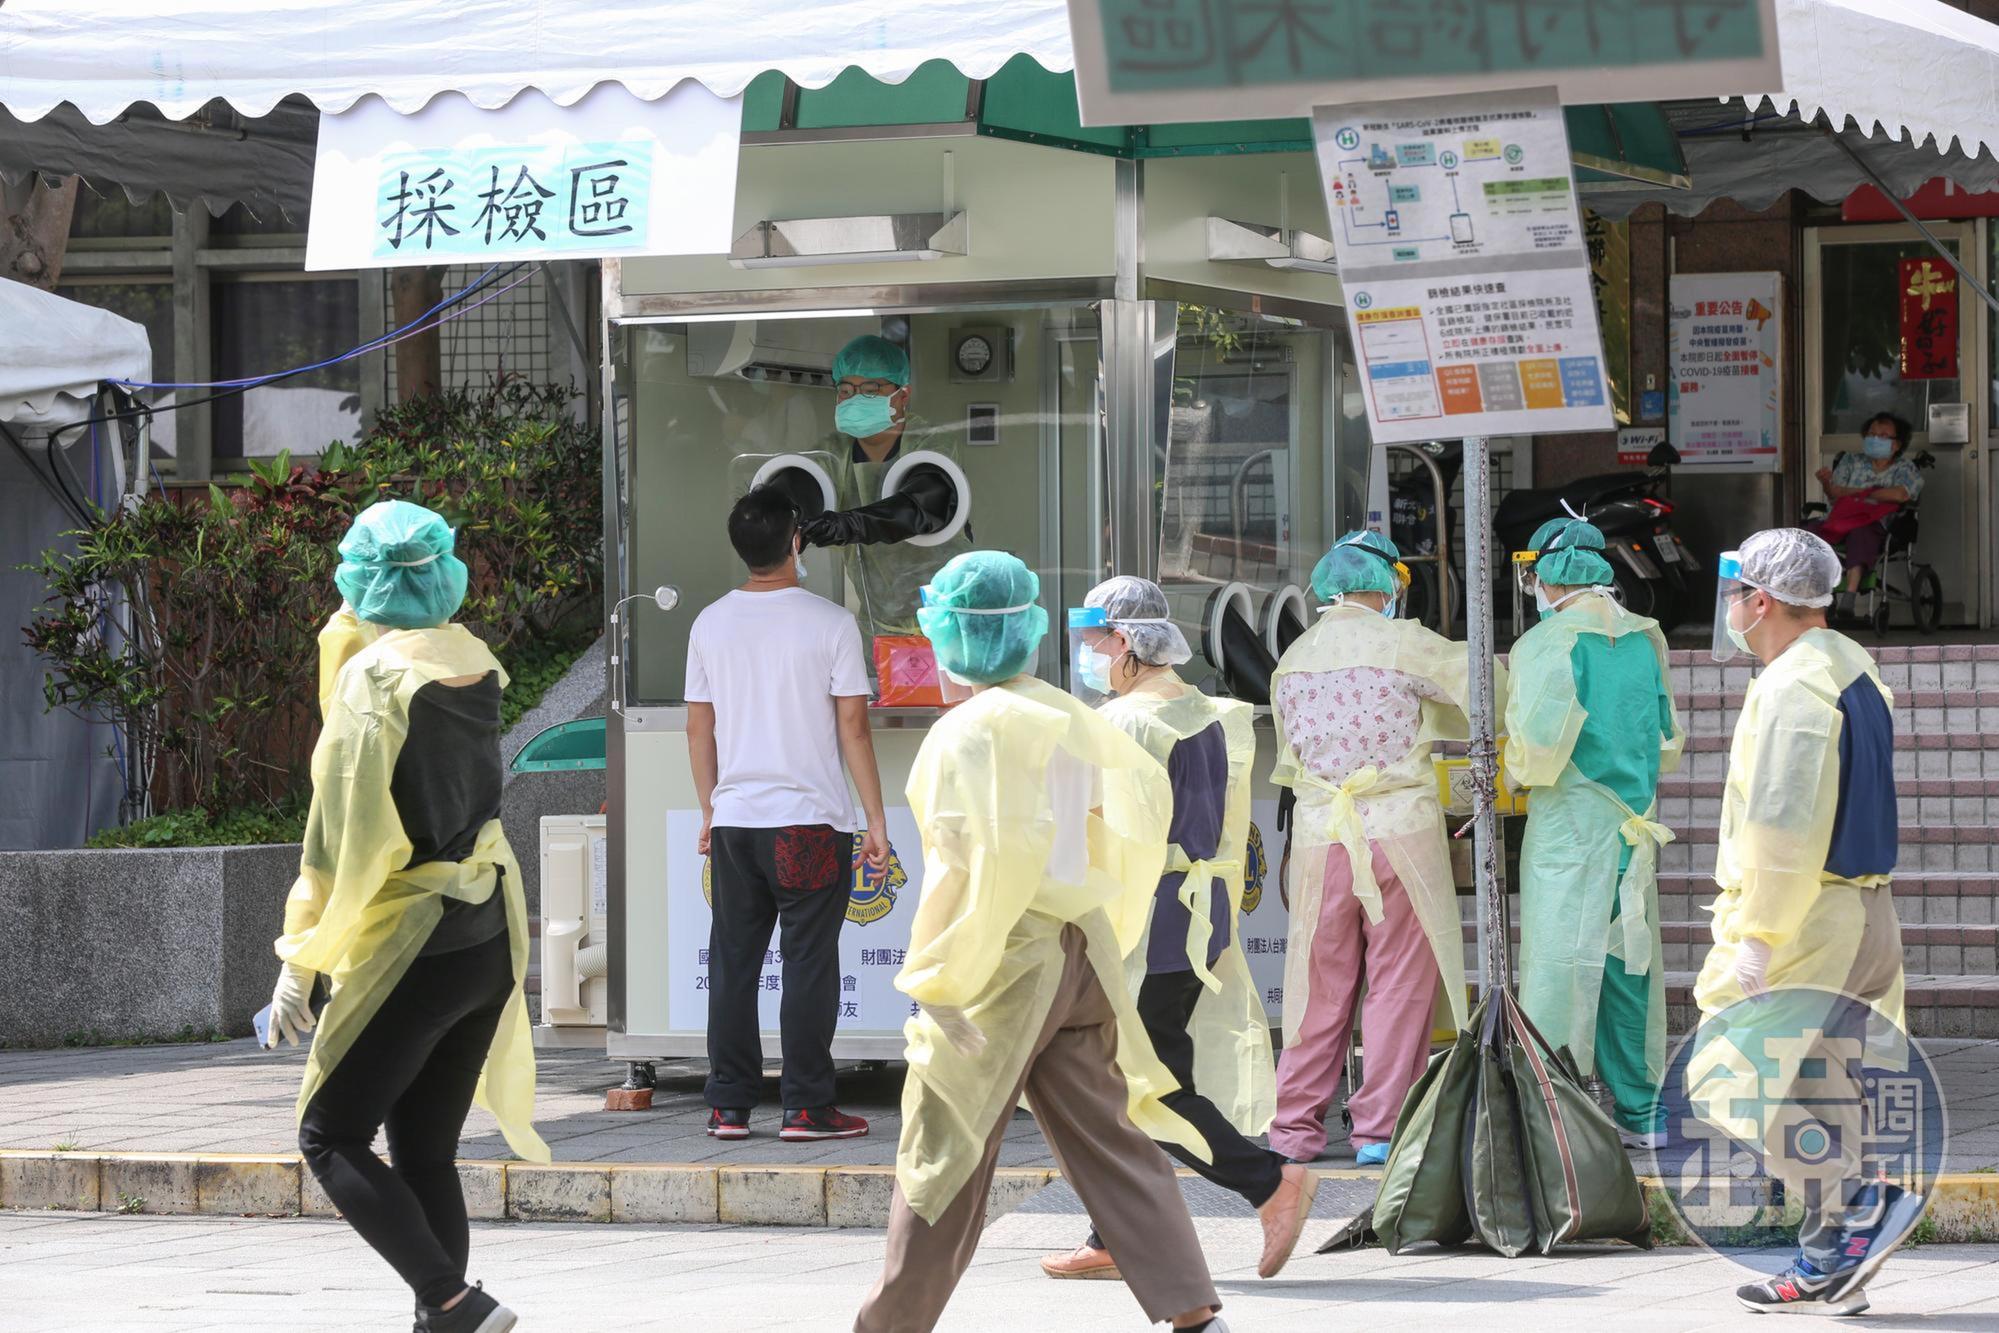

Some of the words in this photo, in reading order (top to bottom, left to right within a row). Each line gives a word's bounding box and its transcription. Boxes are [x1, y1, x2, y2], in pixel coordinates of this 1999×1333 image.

[381, 159, 634, 249] 採檢區
[1694, 300, 1744, 317] 重要公告
[847, 901, 889, 918] ERNATIONAL
